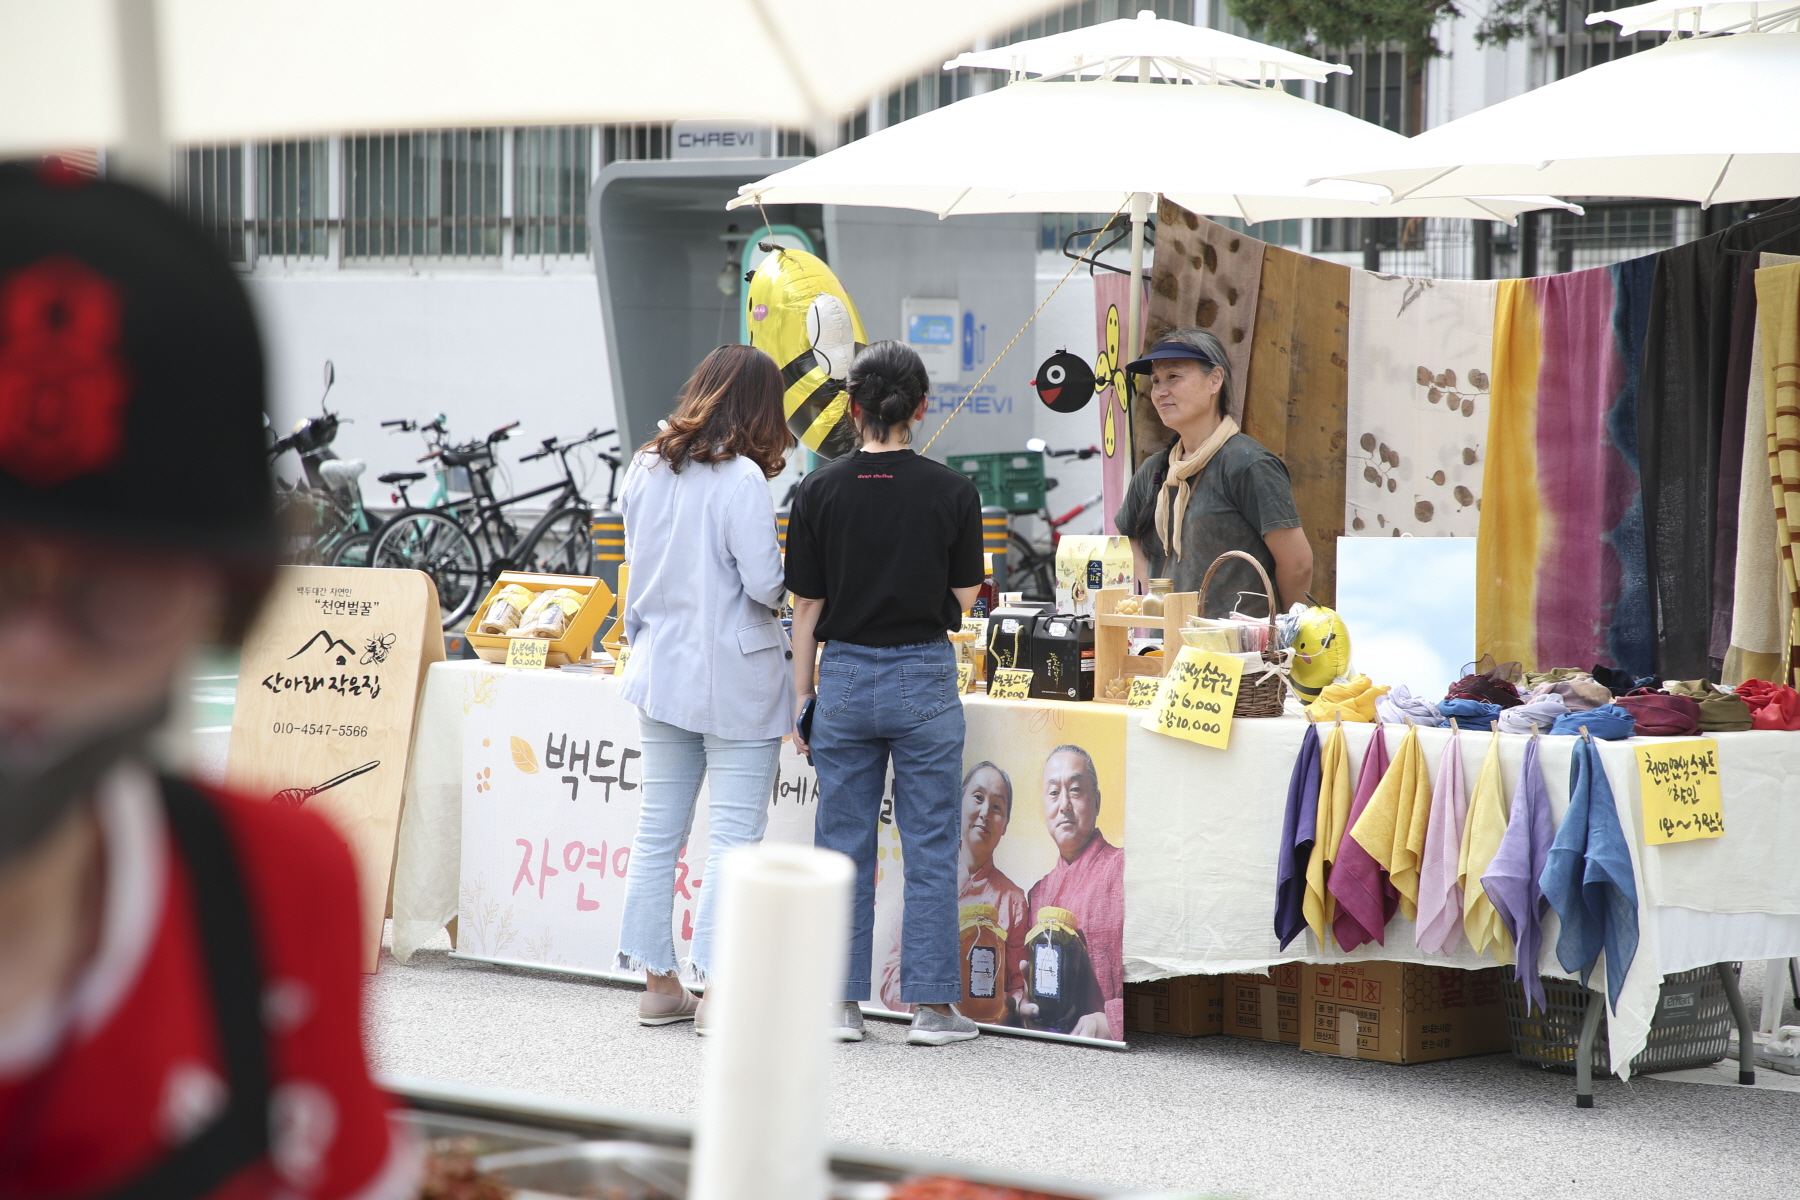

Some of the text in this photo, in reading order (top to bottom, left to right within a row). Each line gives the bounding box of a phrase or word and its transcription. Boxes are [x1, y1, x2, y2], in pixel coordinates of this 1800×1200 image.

[678, 131, 754, 148] CHAEVI
[296, 586, 353, 598] 백두대간 자연인
[512, 656, 542, 667] 60,000
[1127, 698, 1153, 708] 4,00
[1182, 693, 1221, 714] 6,000
[272, 722, 369, 738] 010-4547-5566
[1333, 964, 1365, 976] 취급주의
